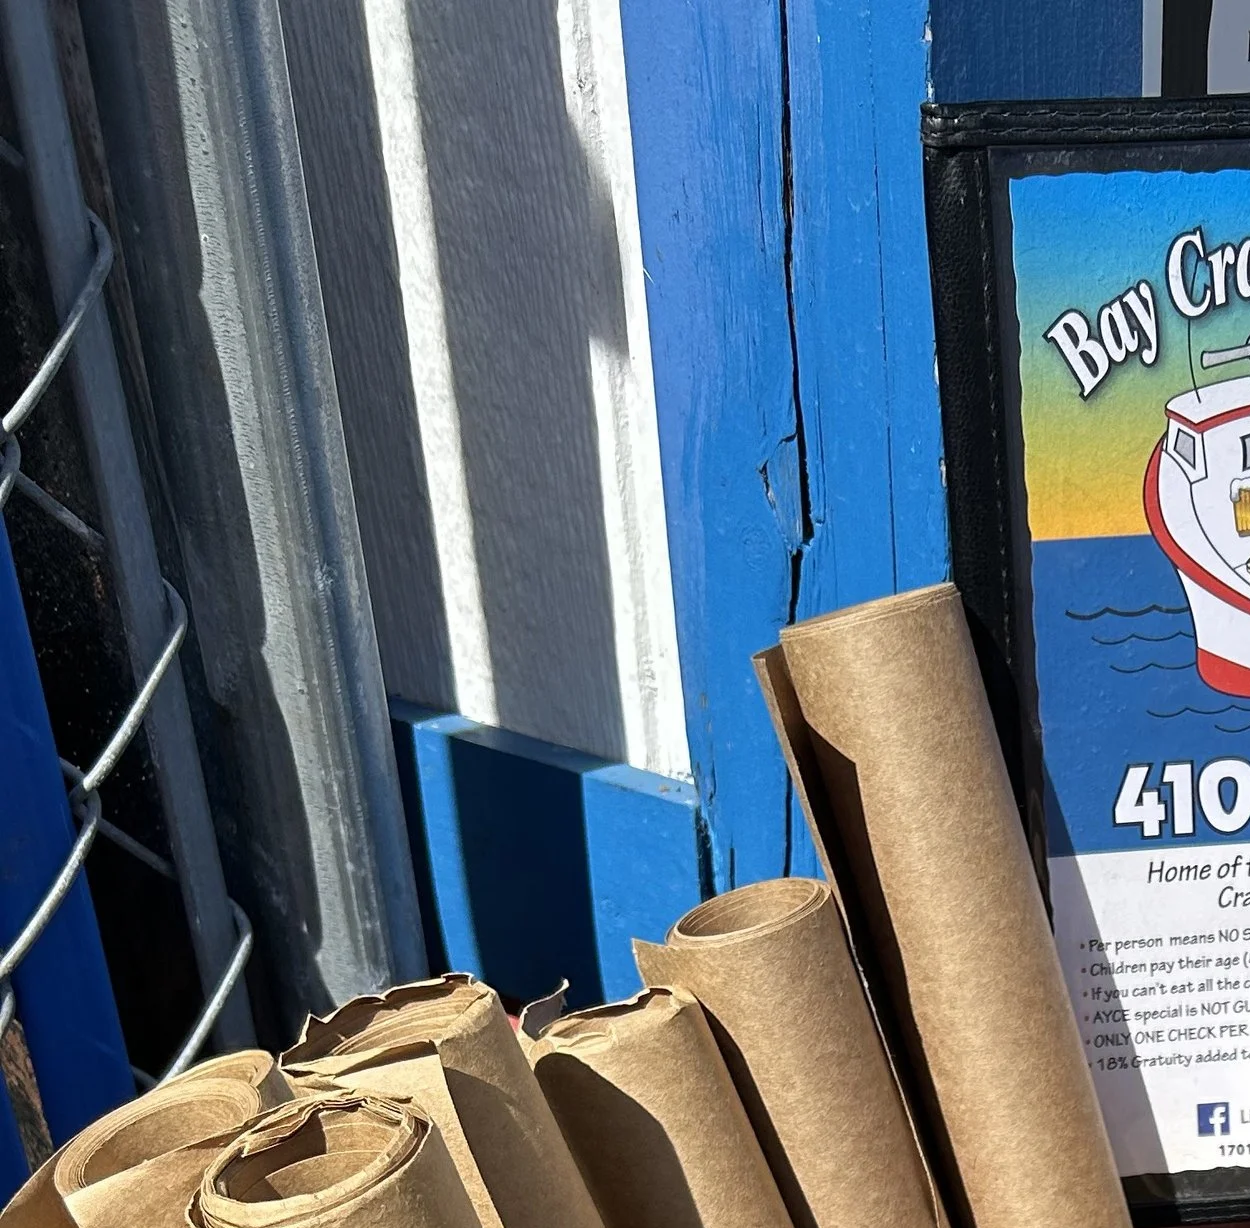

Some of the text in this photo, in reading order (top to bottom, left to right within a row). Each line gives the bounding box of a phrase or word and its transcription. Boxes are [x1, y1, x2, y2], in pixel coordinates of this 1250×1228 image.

[1043, 280, 1160, 400] Bay
[1148, 860, 1212, 883] Home
[1217, 855, 1243, 878] of
[1089, 938, 1111, 952] Per
[1115, 936, 1163, 955] person
[1169, 932, 1216, 946] means
[1218, 928, 1240, 943] NO
[1090, 961, 1147, 976] Children
[1150, 960, 1175, 977] pay
[1177, 955, 1212, 970] their
[1215, 957, 1240, 970] age
[1091, 986, 1102, 1000] If
[1103, 987, 1129, 1003] you
[1132, 981, 1168, 997] can't
[1170, 980, 1195, 994] eat
[1197, 978, 1213, 992] all
[1216, 977, 1240, 991] the
[1092, 1008, 1131, 1024] AYCE
[1134, 1004, 1183, 1025] special
[1185, 1005, 1199, 1018] is
[1201, 1000, 1230, 1016] NOT
[1094, 1031, 1131, 1048] ONLY
[1134, 1030, 1165, 1045] ONE
[1167, 1026, 1217, 1042] CHECK
[1219, 1023, 1250, 1038] PER
[1097, 1056, 1129, 1071] 18%
[1131, 1053, 1192, 1069] Gratuity
[1195, 1048, 1238, 1063] added
